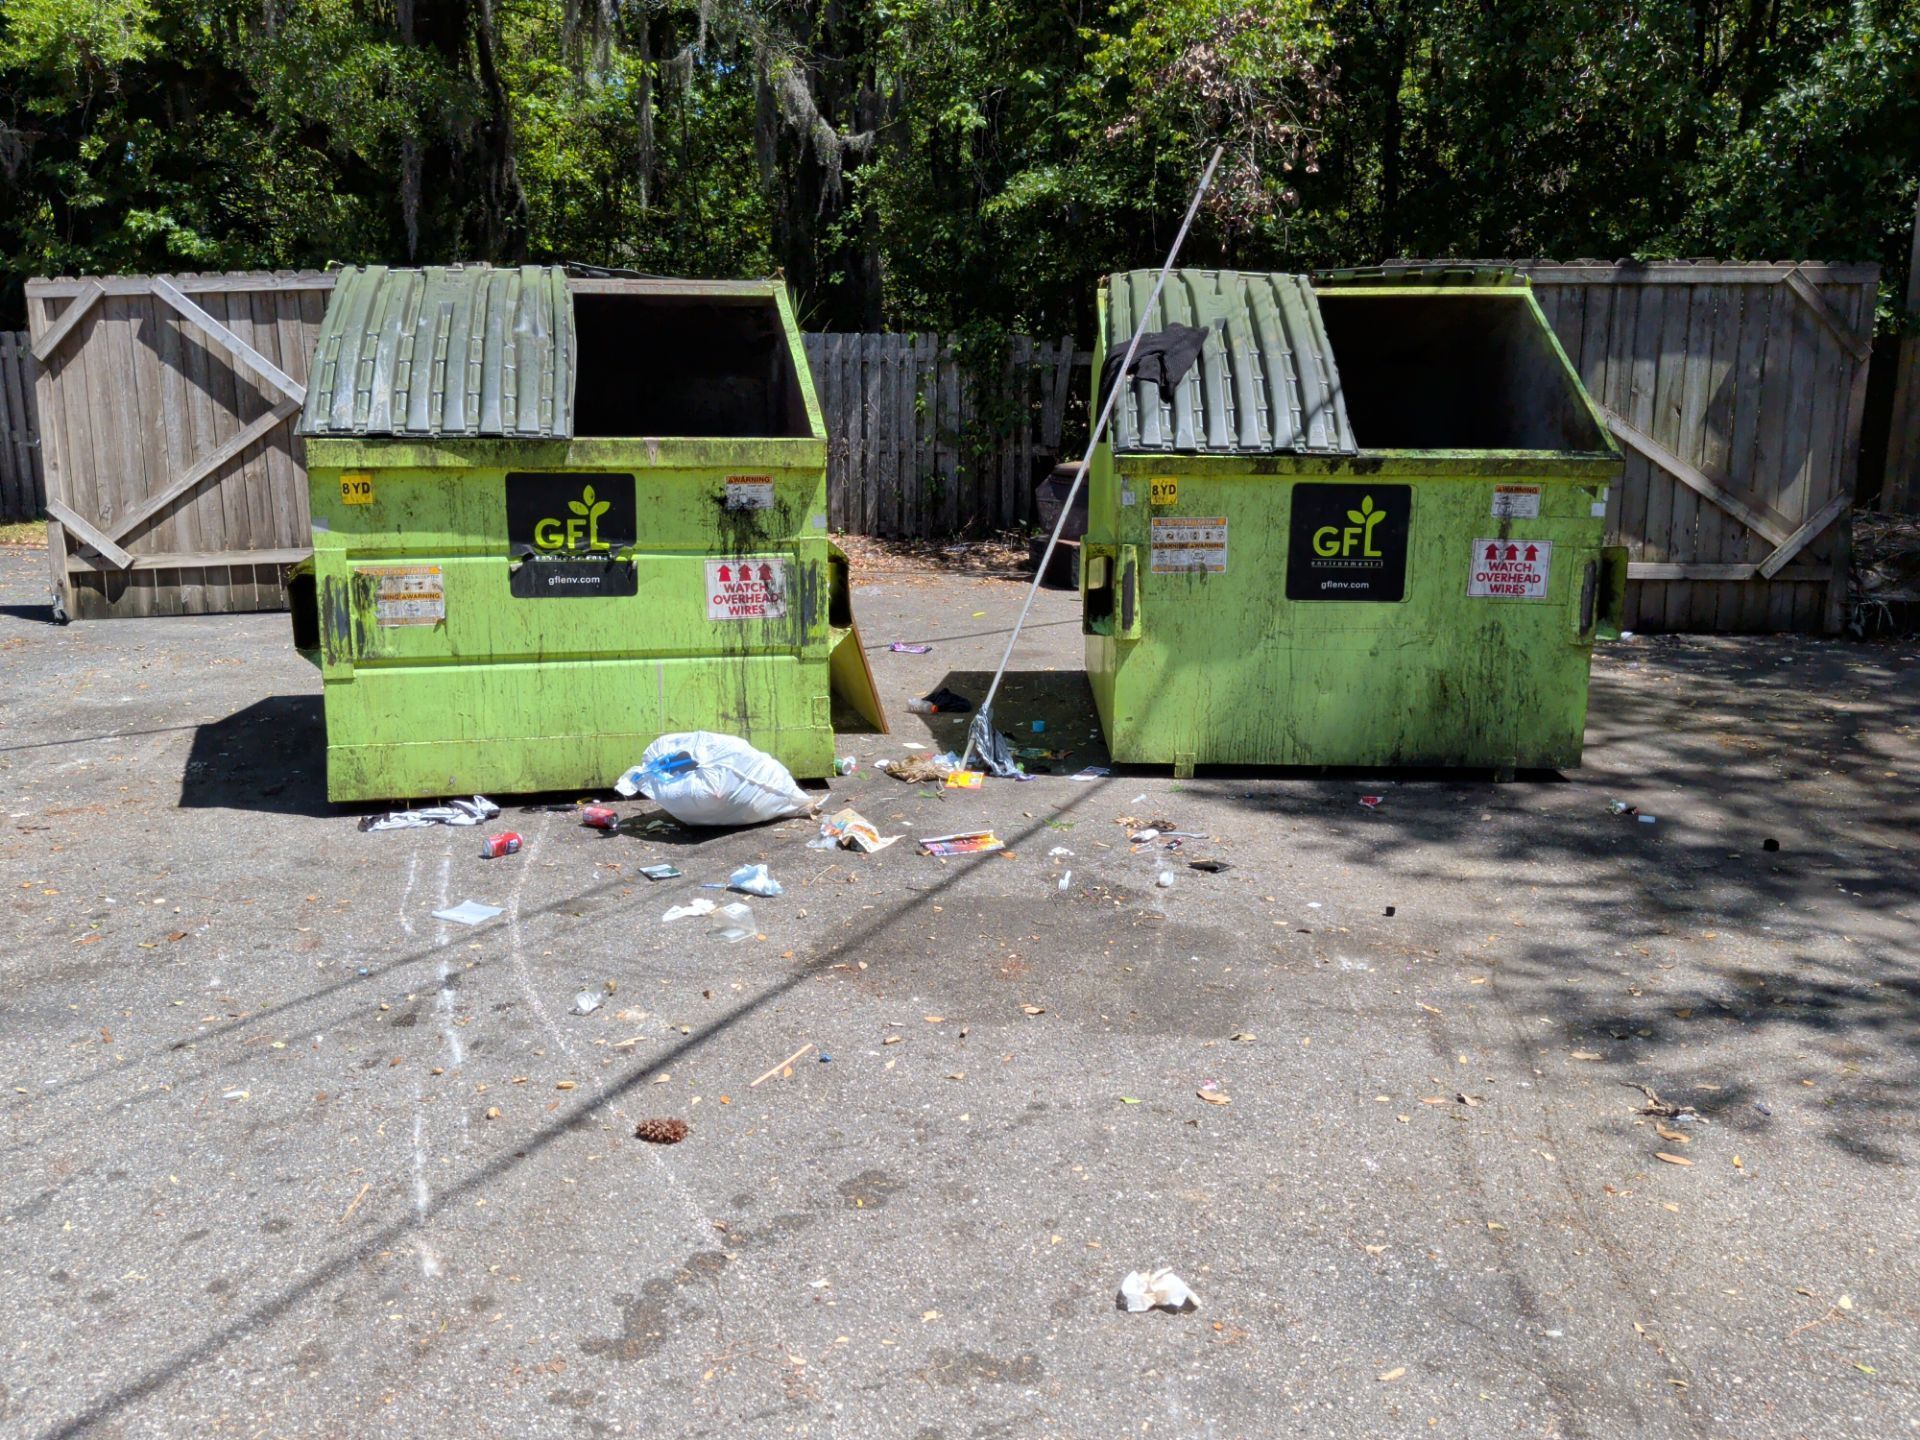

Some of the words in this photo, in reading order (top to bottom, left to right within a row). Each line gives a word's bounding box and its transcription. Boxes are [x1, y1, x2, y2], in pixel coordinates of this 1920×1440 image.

[733, 475, 771, 483] WARNING
[1503, 486, 1538, 494] WARNING
[534, 501, 610, 550] GFL
[1312, 511, 1387, 557] GFL
[1488, 561, 1533, 573] WATCH
[547, 575, 600, 587] gflenv.com
[1475, 572, 1542, 584] OVERHEAD
[723, 582, 770, 593] WATCH
[1321, 580, 1370, 590] gflenv.com
[1489, 583, 1526, 594] WIRES
[712, 593, 779, 605] OVERHEAD
[728, 604, 766, 616] WIRES
